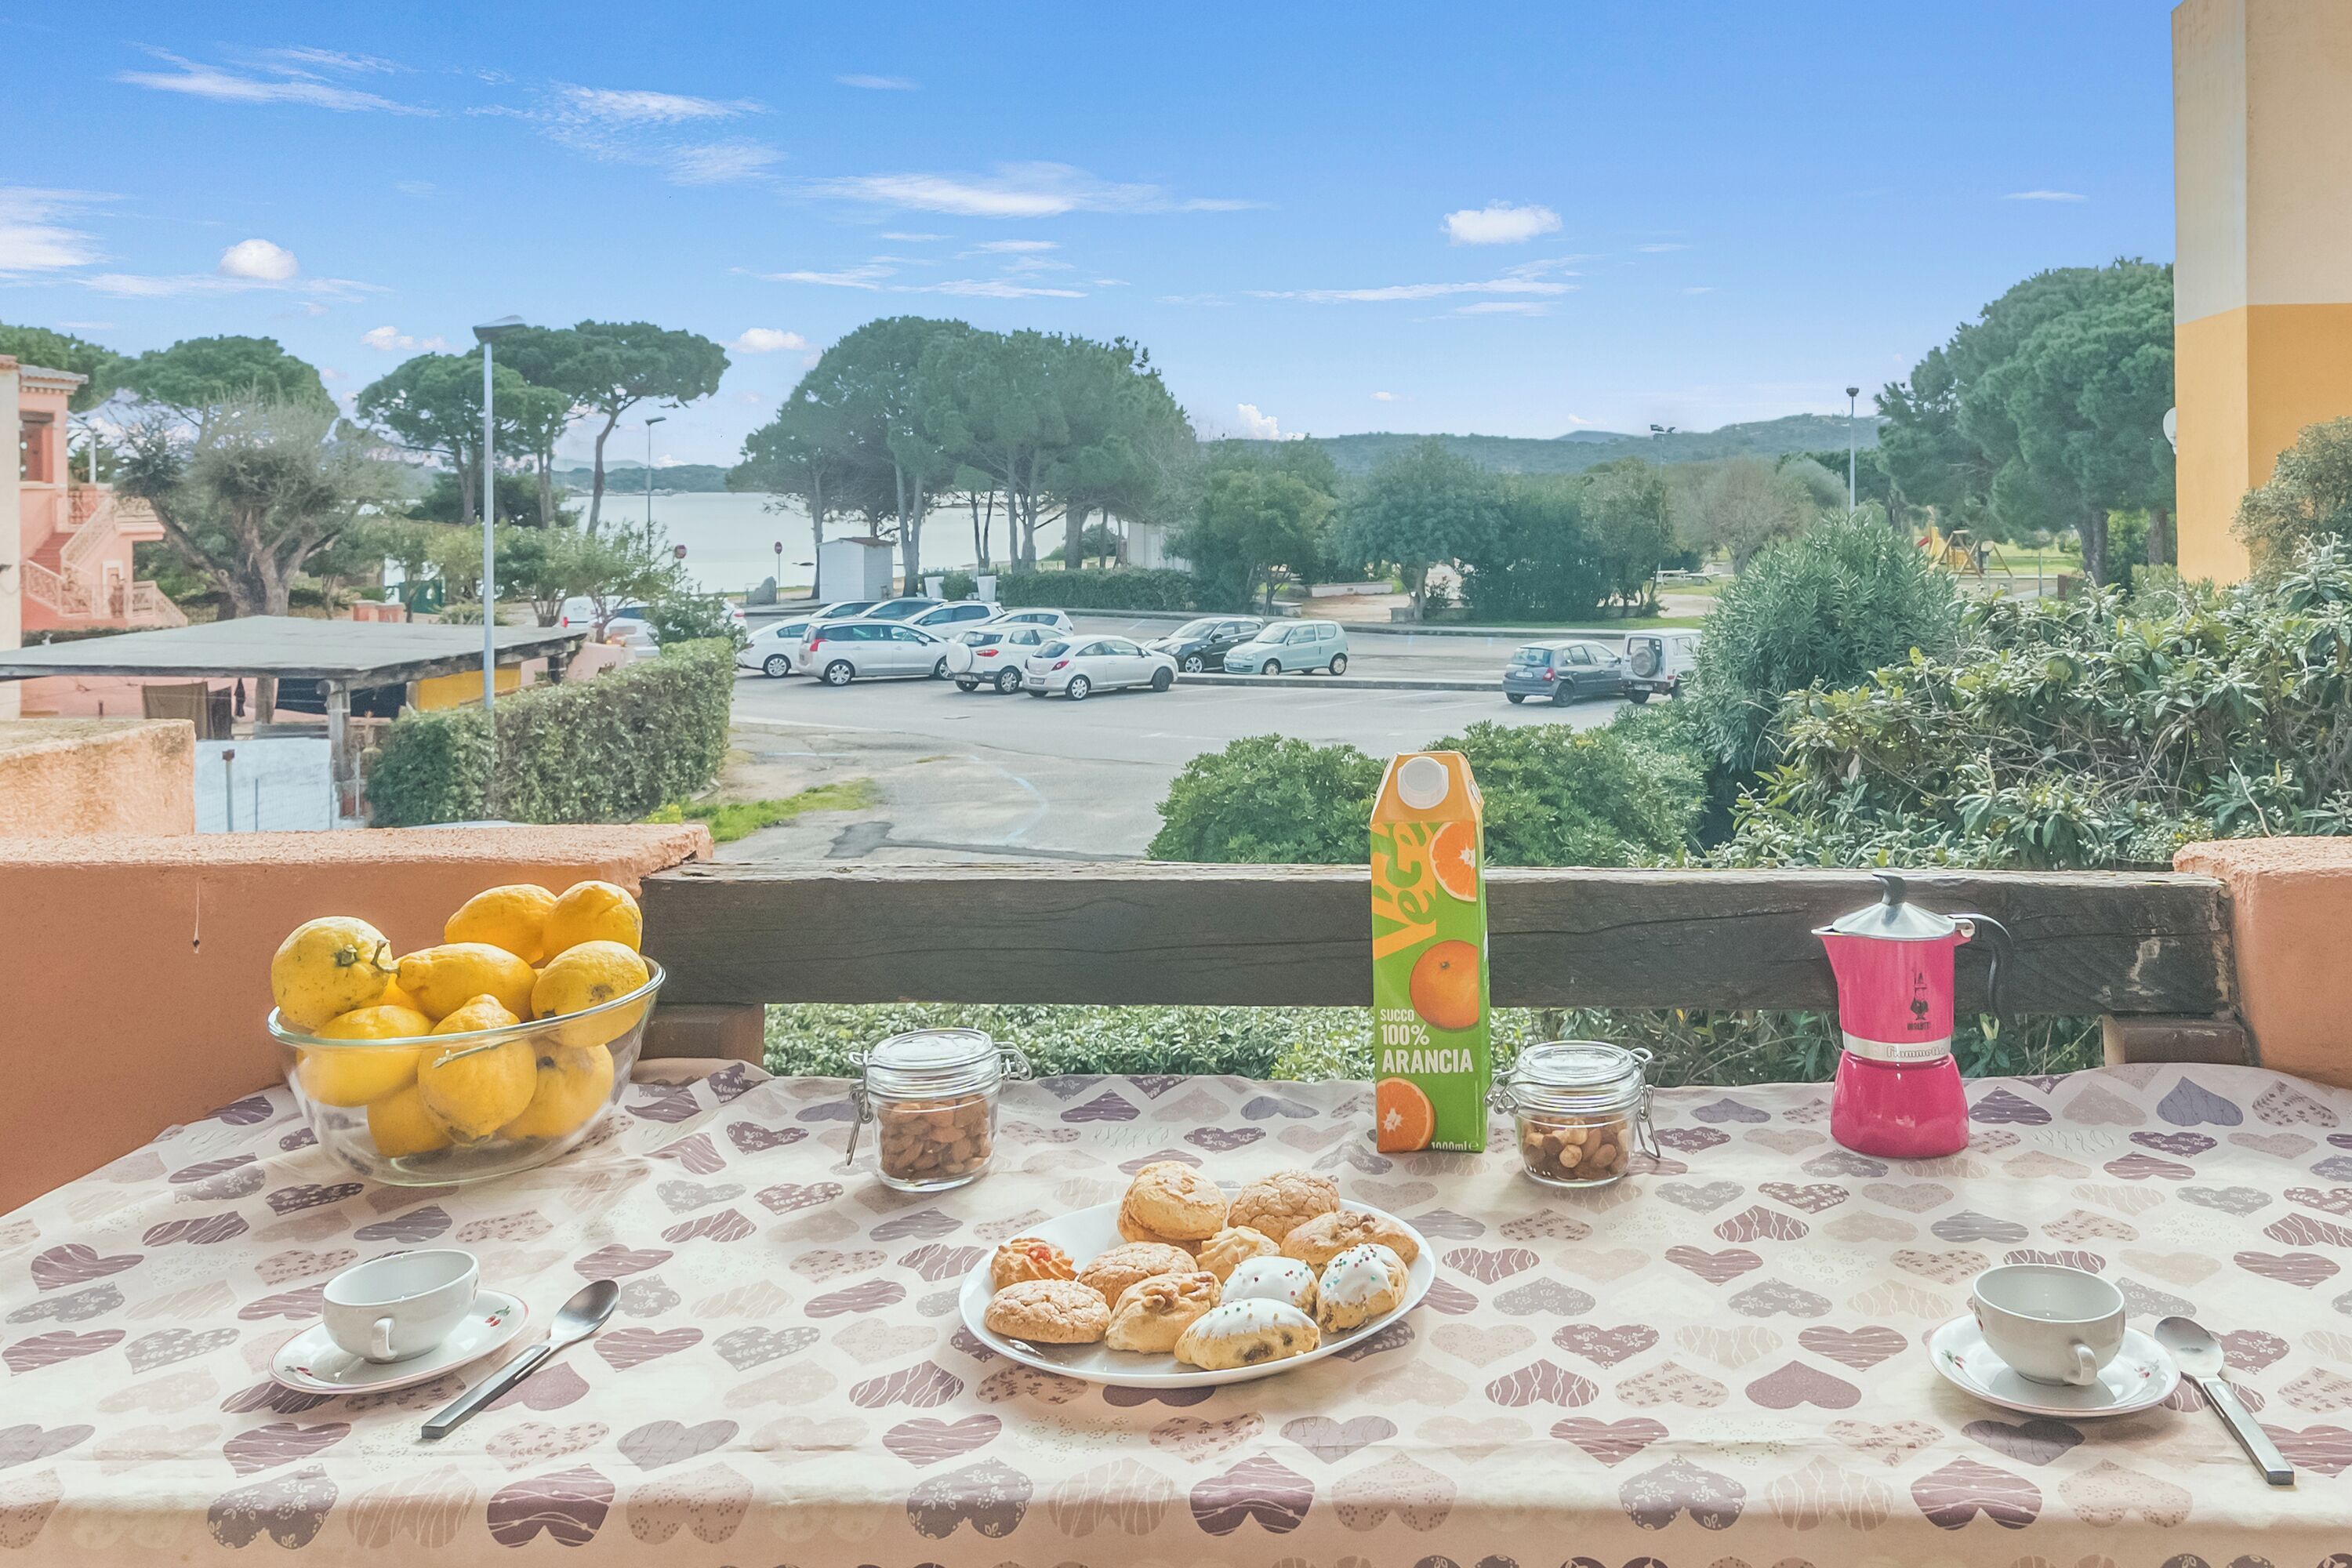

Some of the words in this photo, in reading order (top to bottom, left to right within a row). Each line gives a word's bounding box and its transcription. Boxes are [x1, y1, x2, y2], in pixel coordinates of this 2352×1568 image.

[1380, 1008, 1414, 1022] SUCCO
[1381, 1024, 1430, 1046] 100%
[1381, 1048, 1474, 1074] ARANCIA
